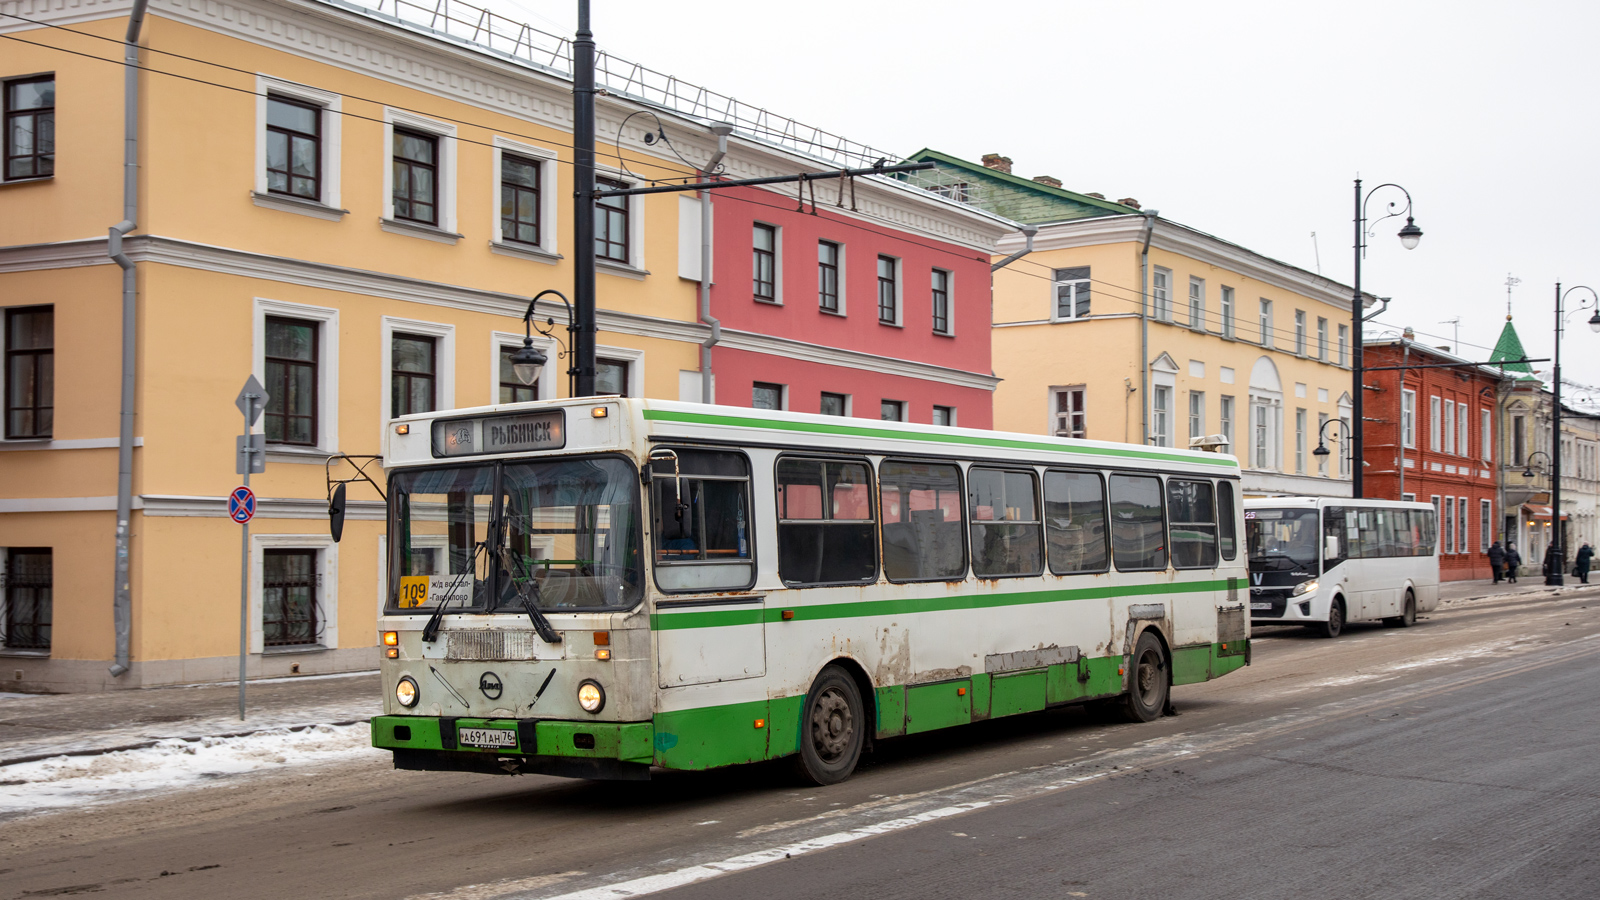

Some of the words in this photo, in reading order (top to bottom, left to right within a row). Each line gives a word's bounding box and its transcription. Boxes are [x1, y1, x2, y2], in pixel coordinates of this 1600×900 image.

[491, 421, 552, 445] РЫБИНСК
[1245, 511, 1256, 519] 25
[431, 580, 443, 589] ж/д
[1252, 572, 1264, 586] V
[403, 583, 426, 600] 109
